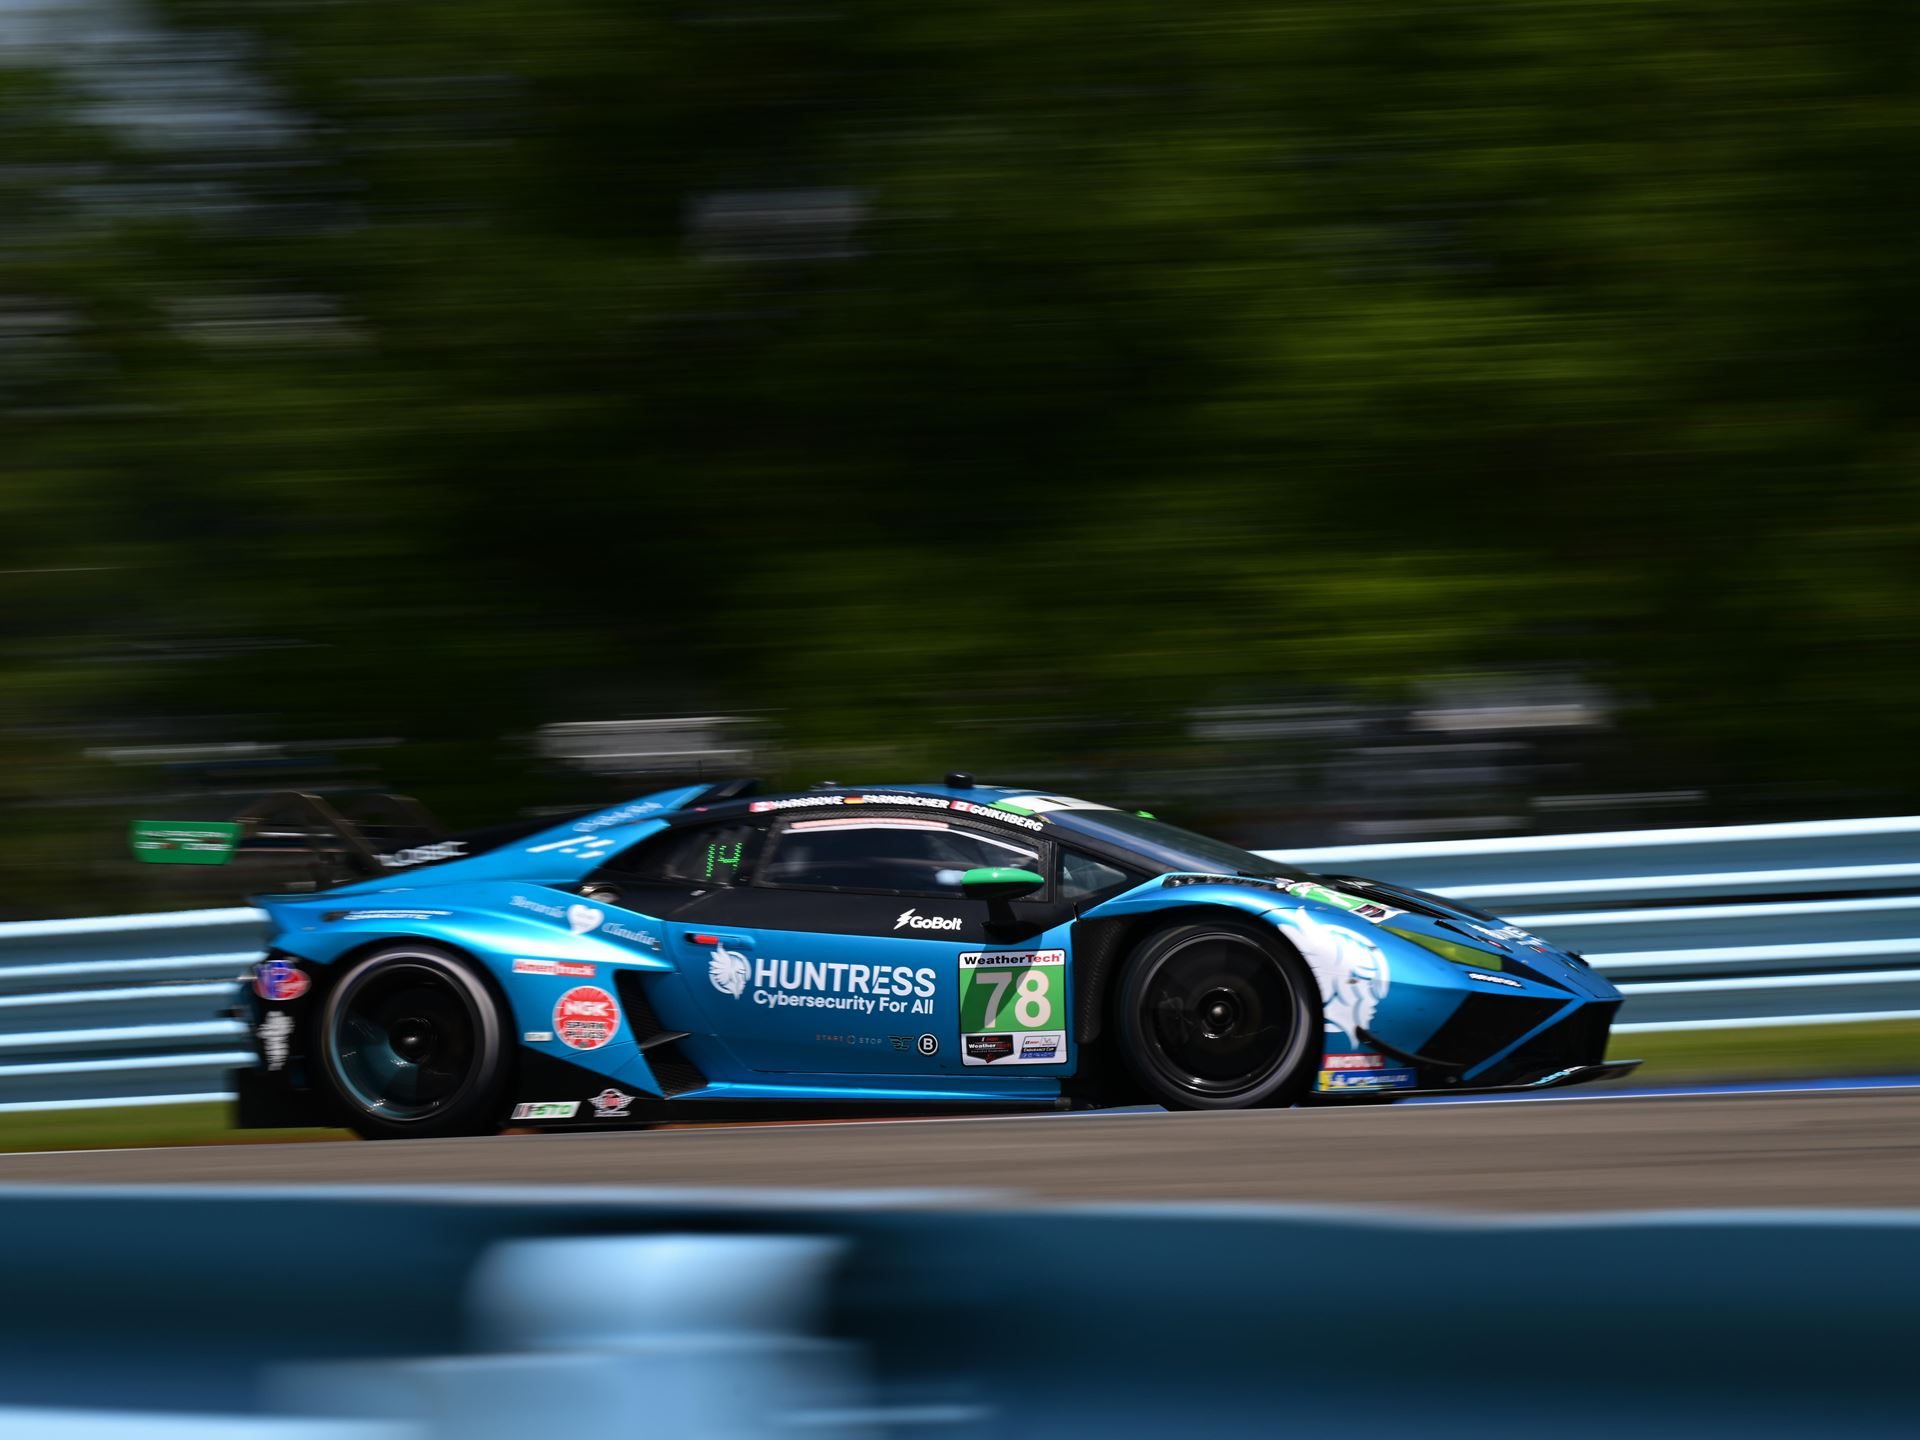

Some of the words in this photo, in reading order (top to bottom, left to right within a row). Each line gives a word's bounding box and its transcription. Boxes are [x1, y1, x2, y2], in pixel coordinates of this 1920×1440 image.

[863, 795, 950, 809] FARNBACHER
[970, 806, 1043, 832] GOIKHBERG
[706, 842, 742, 877] 14
[910, 916, 963, 931] GoBolt
[964, 953, 1062, 965] WeatherTech
[754, 958, 937, 998] HUNTRESS
[563, 1000, 610, 1016] NGK
[753, 990, 875, 1014] Cybersecurity
[879, 997, 908, 1012] For
[911, 999, 934, 1014] All
[976, 970, 1051, 1028] 78
